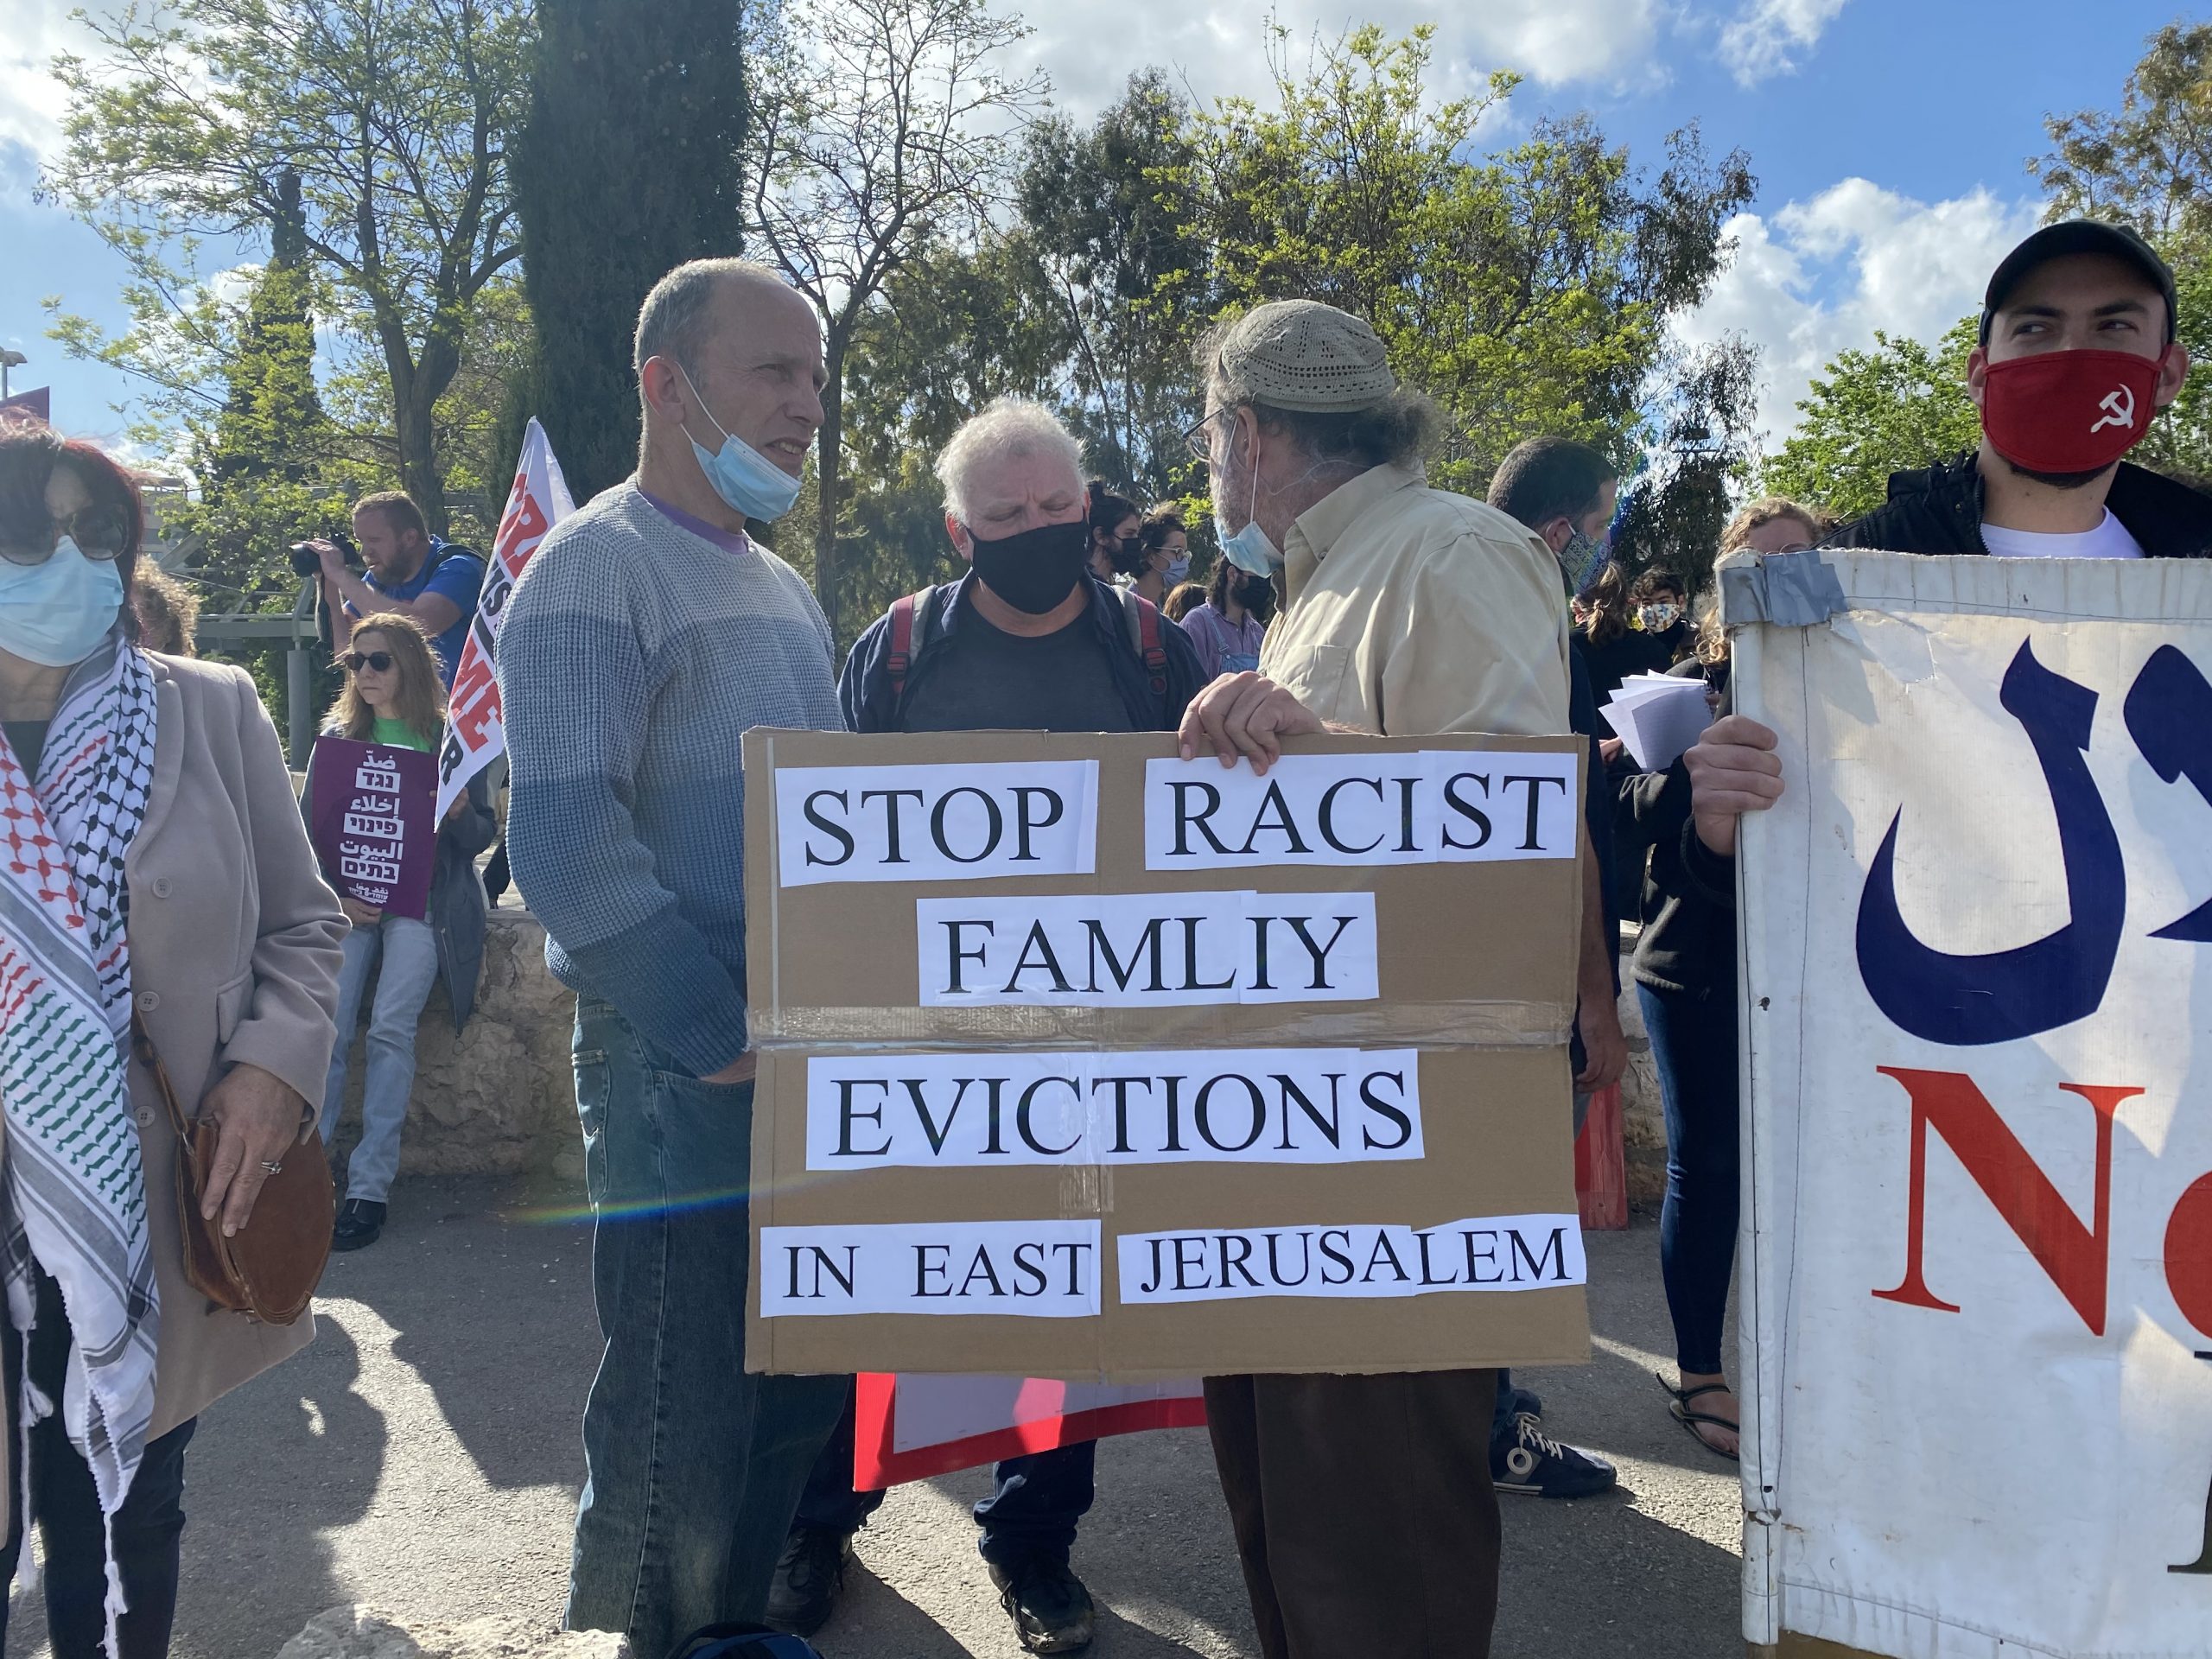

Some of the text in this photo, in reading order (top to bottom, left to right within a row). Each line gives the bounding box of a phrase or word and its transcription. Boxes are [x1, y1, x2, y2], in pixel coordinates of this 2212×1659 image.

[361, 770, 396, 790] נגד
[340, 840, 404, 862] البيوت
[347, 816, 398, 836] פינוי
[804, 772, 1566, 867] STOP RACIST
[343, 859, 397, 880] בתים
[939, 916, 1357, 993] FAMLIY
[829, 1071, 1412, 1156] EVICTIONS
[1871, 1065, 2212, 1341] N
[783, 1229, 1572, 1298] IN EAST JERUSALEM
